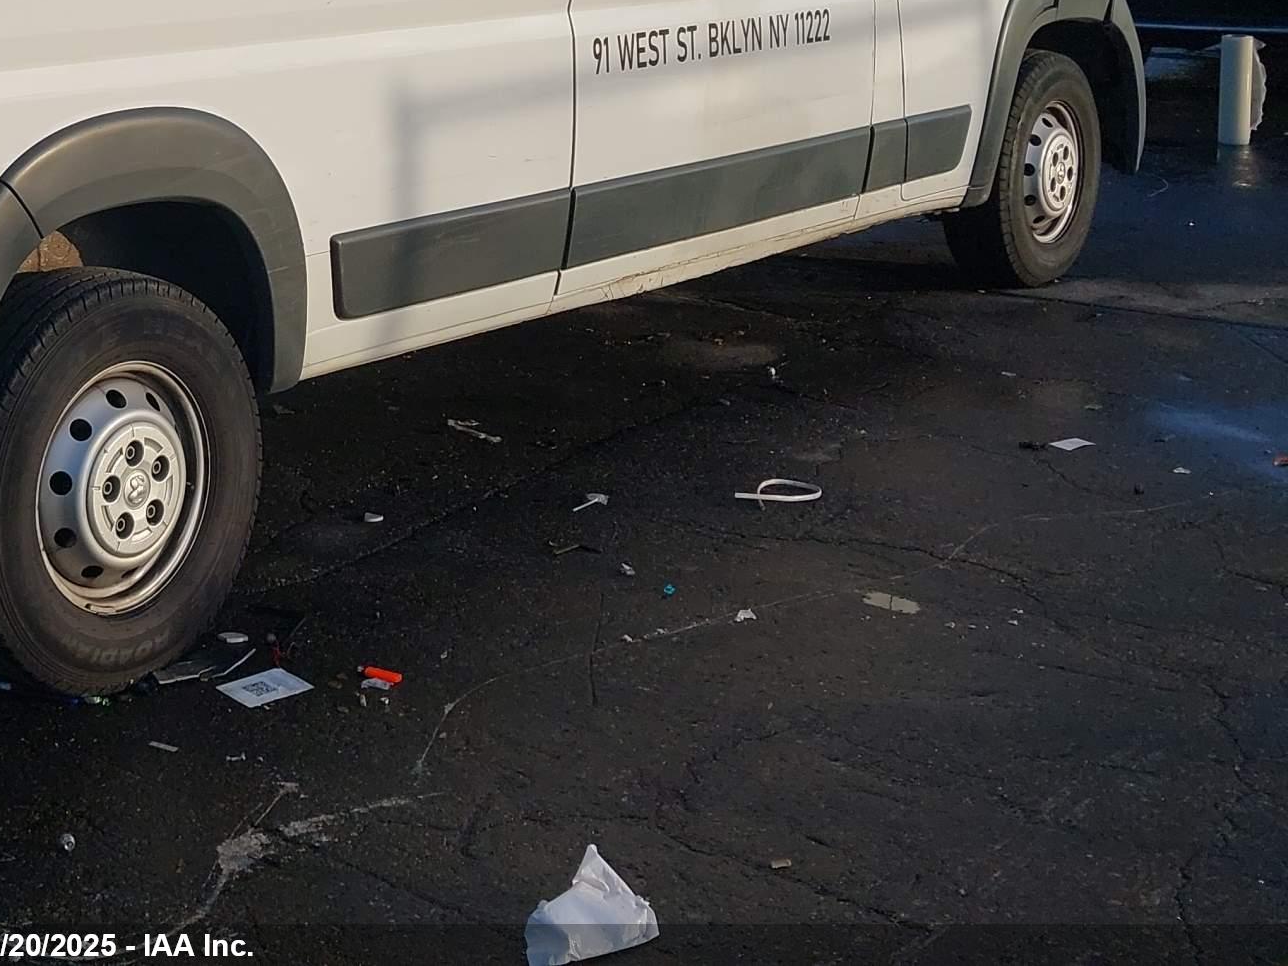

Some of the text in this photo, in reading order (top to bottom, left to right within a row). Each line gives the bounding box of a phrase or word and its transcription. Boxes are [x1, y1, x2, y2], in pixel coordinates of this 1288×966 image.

[592, 8, 831, 75] 91 WEST ST. BKLYN NY 11222
